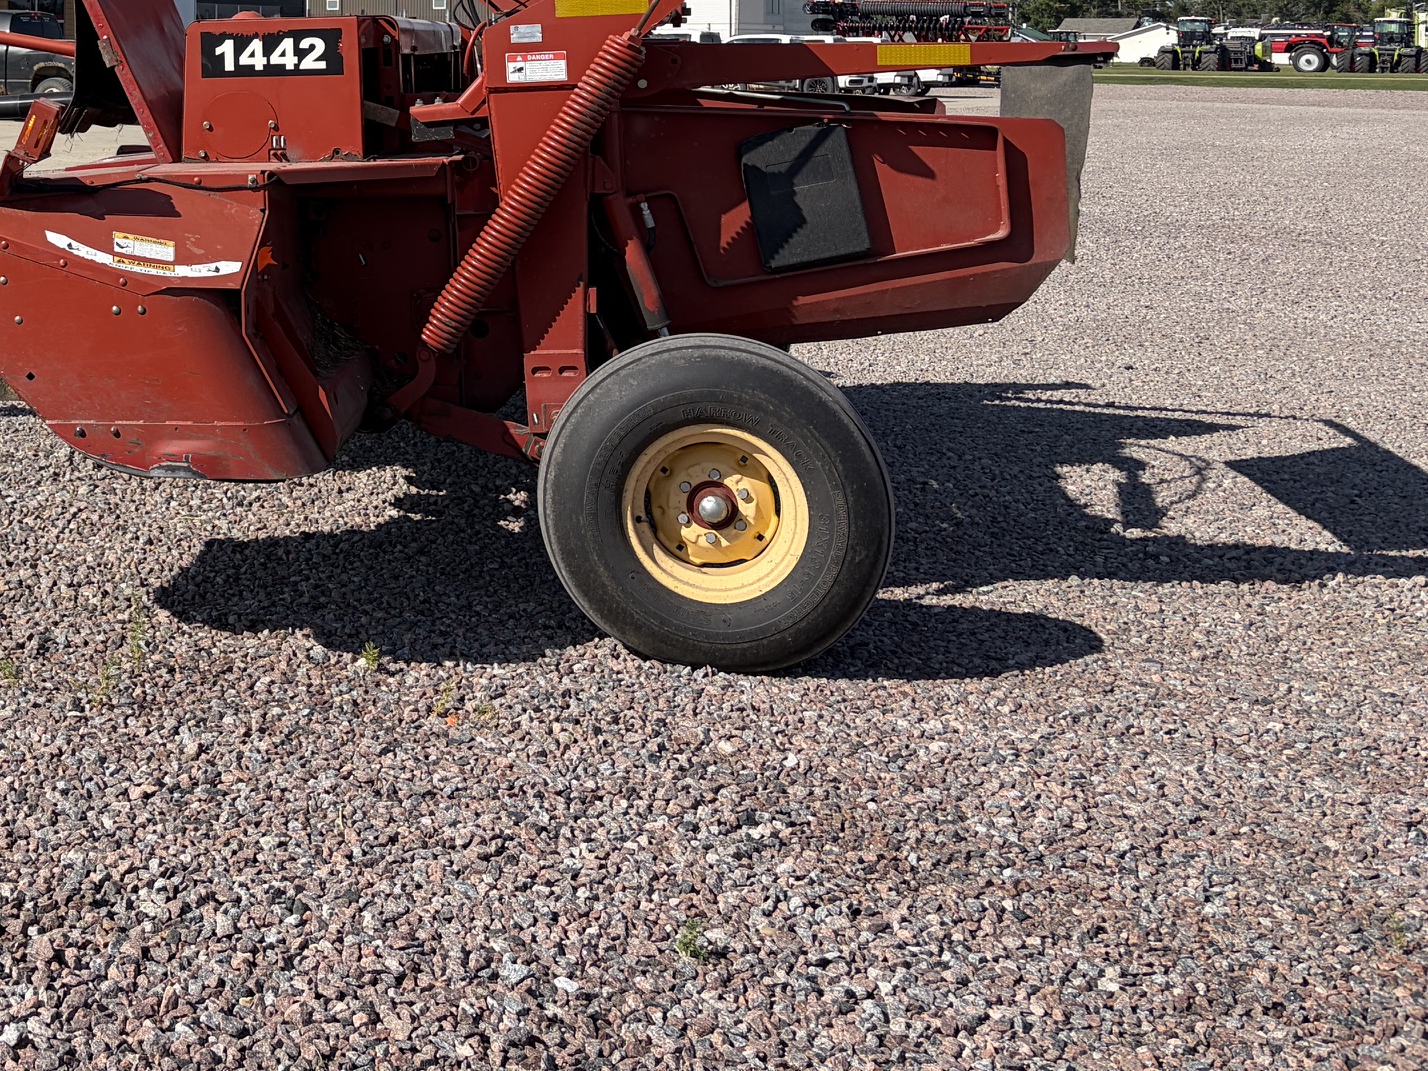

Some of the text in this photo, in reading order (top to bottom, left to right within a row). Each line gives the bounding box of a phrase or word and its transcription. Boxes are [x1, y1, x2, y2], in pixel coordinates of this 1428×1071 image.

[215, 37, 326, 71] 1442
[133, 236, 167, 246] WARNING
[128, 260, 171, 271] WARNING
[681, 406, 815, 471] HARROW TRACK
[777, 565, 840, 628] PROTECTION
